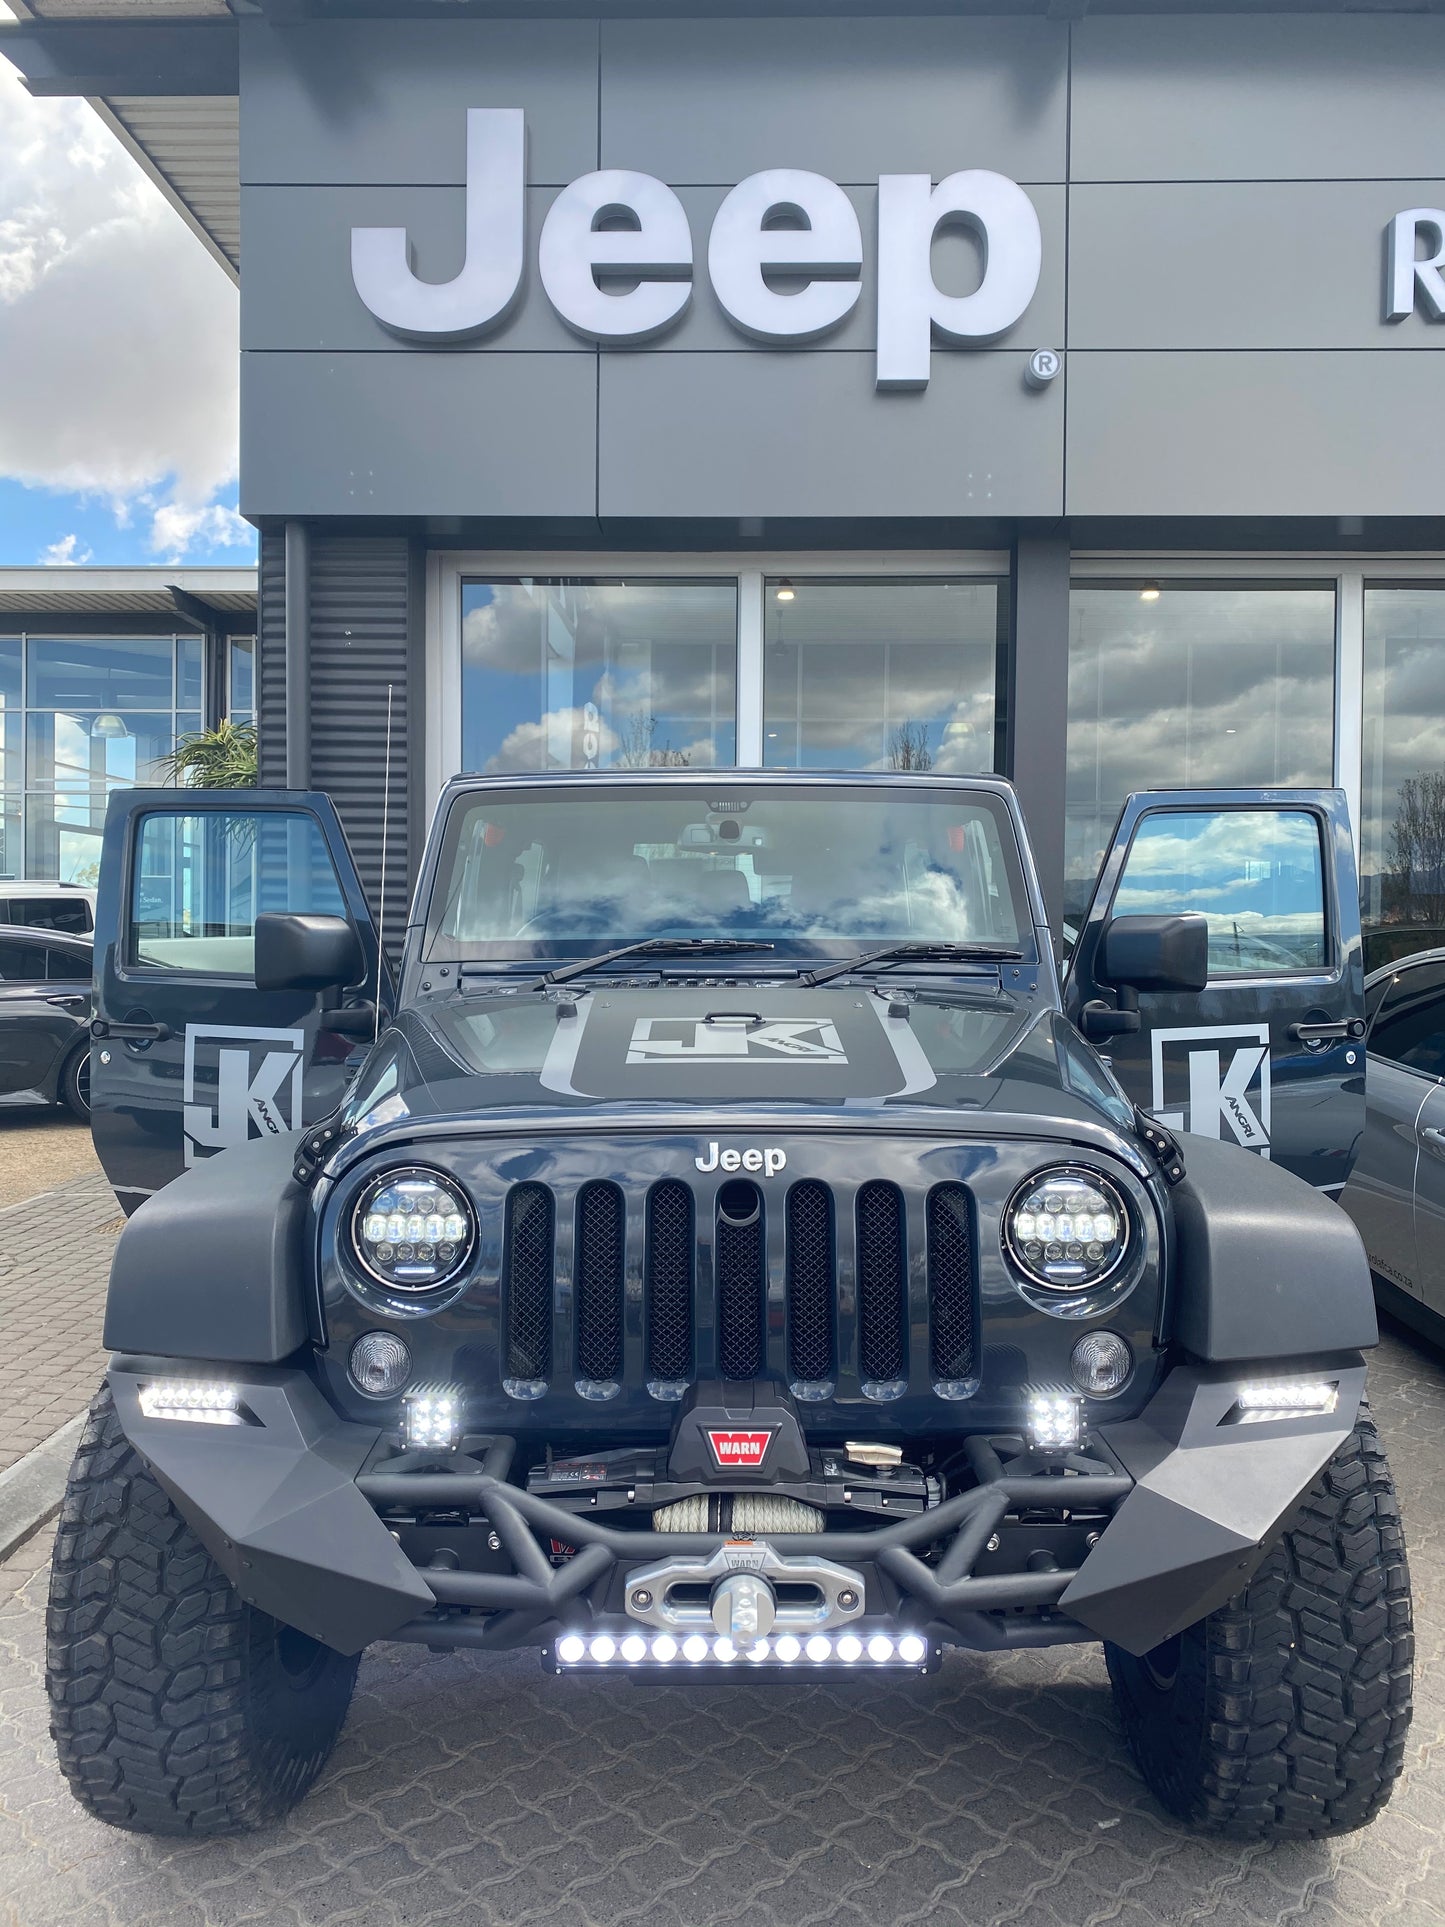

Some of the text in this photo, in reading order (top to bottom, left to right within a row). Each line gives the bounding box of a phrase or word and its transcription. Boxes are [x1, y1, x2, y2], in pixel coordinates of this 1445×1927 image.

[350, 107, 1042, 388] Jeep
[629, 1023, 845, 1055] JK
[183, 1048, 299, 1149] JK
[1224, 1096, 1256, 1138] ANGRI
[694, 1141, 787, 1177] Jeep
[719, 1441, 761, 1455] WARN
[731, 1559, 759, 1568] WARN
